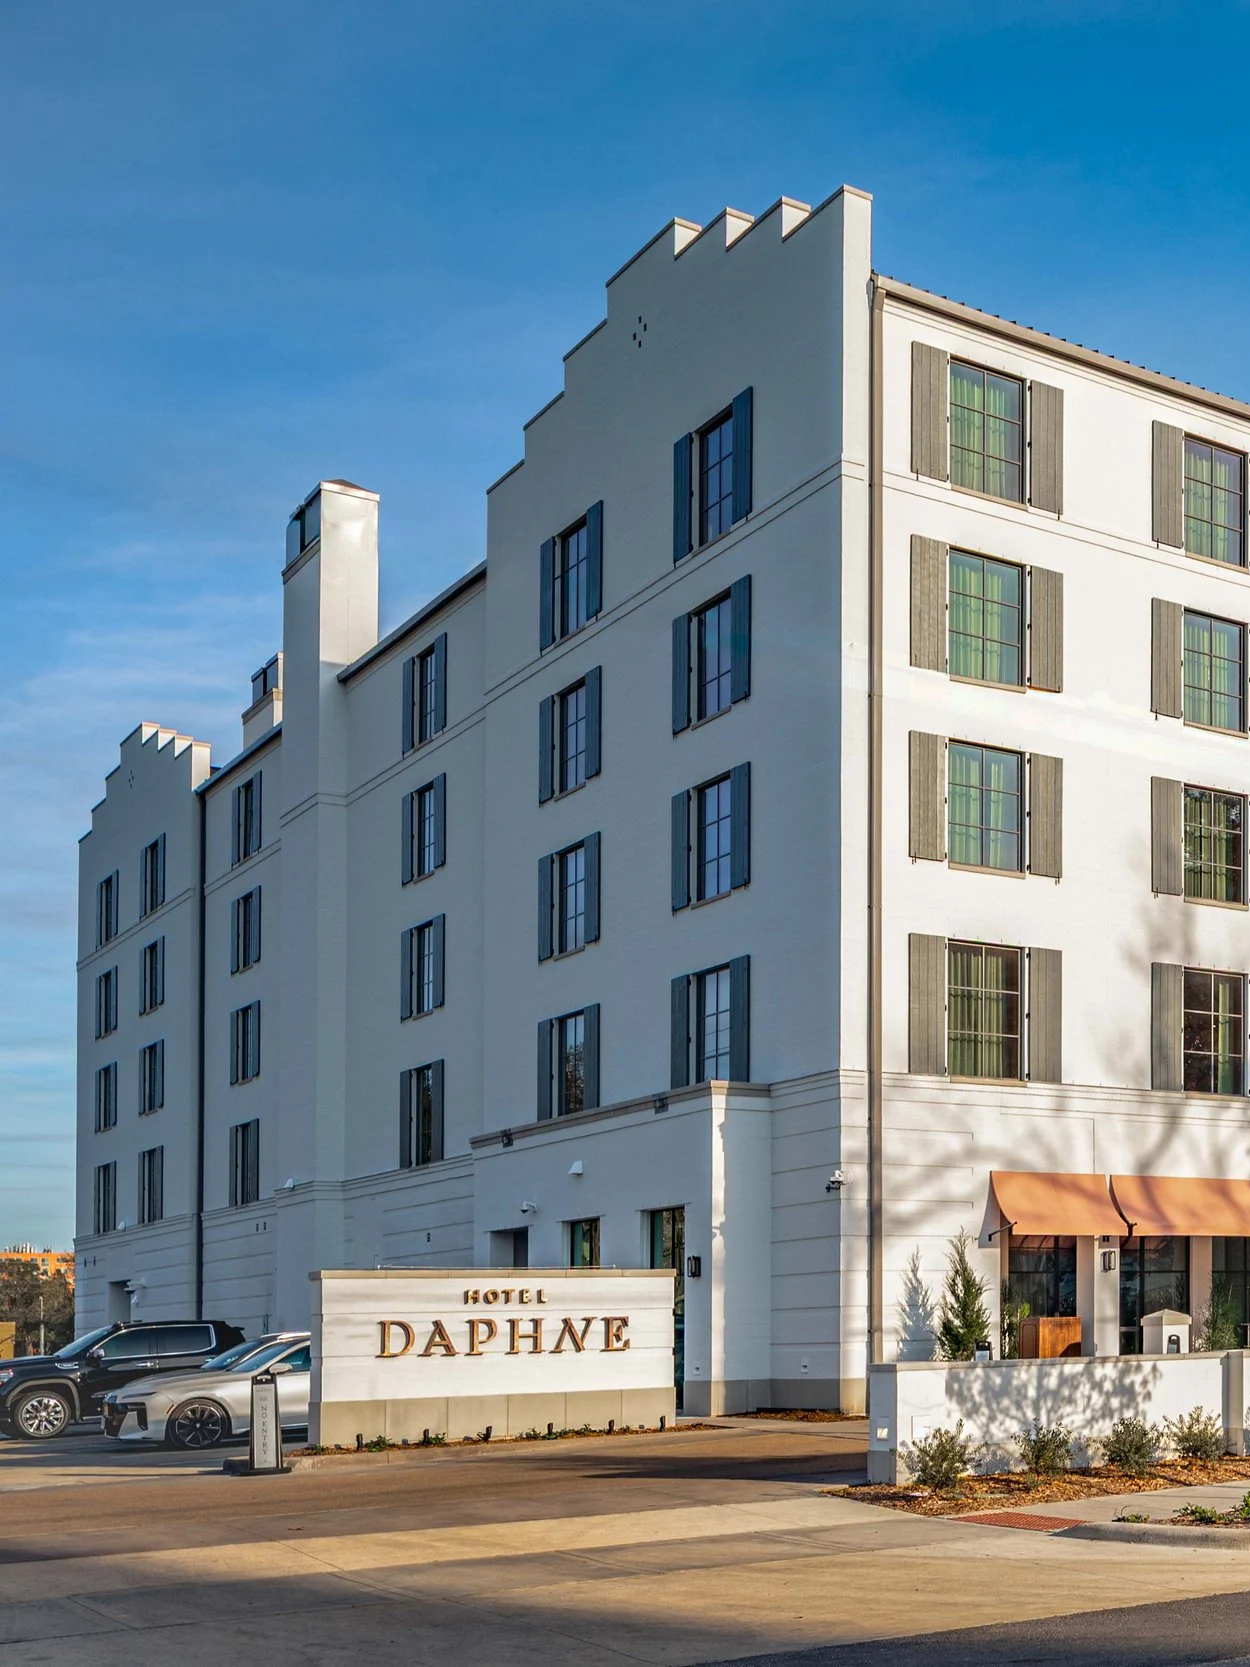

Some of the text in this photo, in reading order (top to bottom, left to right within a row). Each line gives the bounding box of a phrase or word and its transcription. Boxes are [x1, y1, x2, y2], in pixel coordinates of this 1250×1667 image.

[463, 1287, 549, 1305] HOTEL
[374, 1315, 631, 1358] DAPHNE
[261, 1405, 268, 1419] NO
